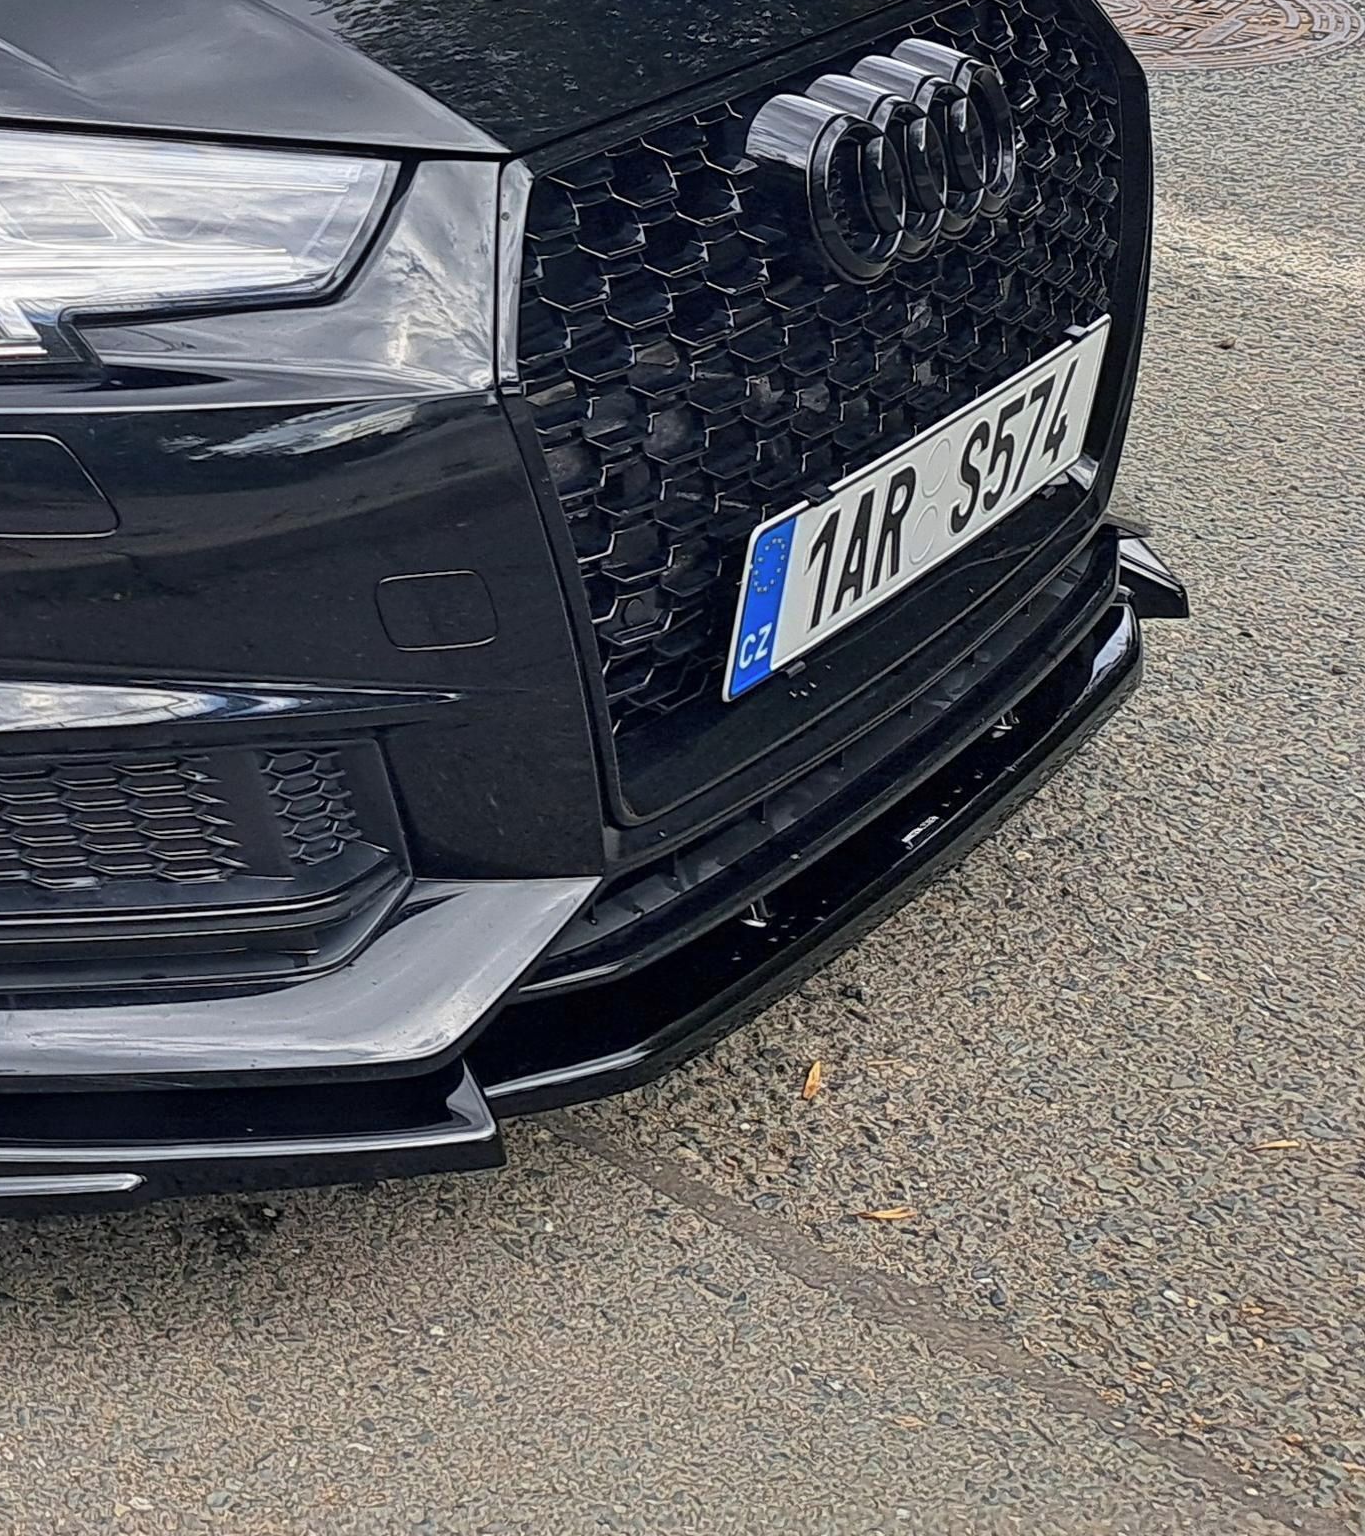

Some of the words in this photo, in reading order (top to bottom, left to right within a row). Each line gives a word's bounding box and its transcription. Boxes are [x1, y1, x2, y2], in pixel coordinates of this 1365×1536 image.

[805, 463, 917, 633] 1AR
[950, 356, 1078, 536] S574
[737, 622, 773, 671] CZ
